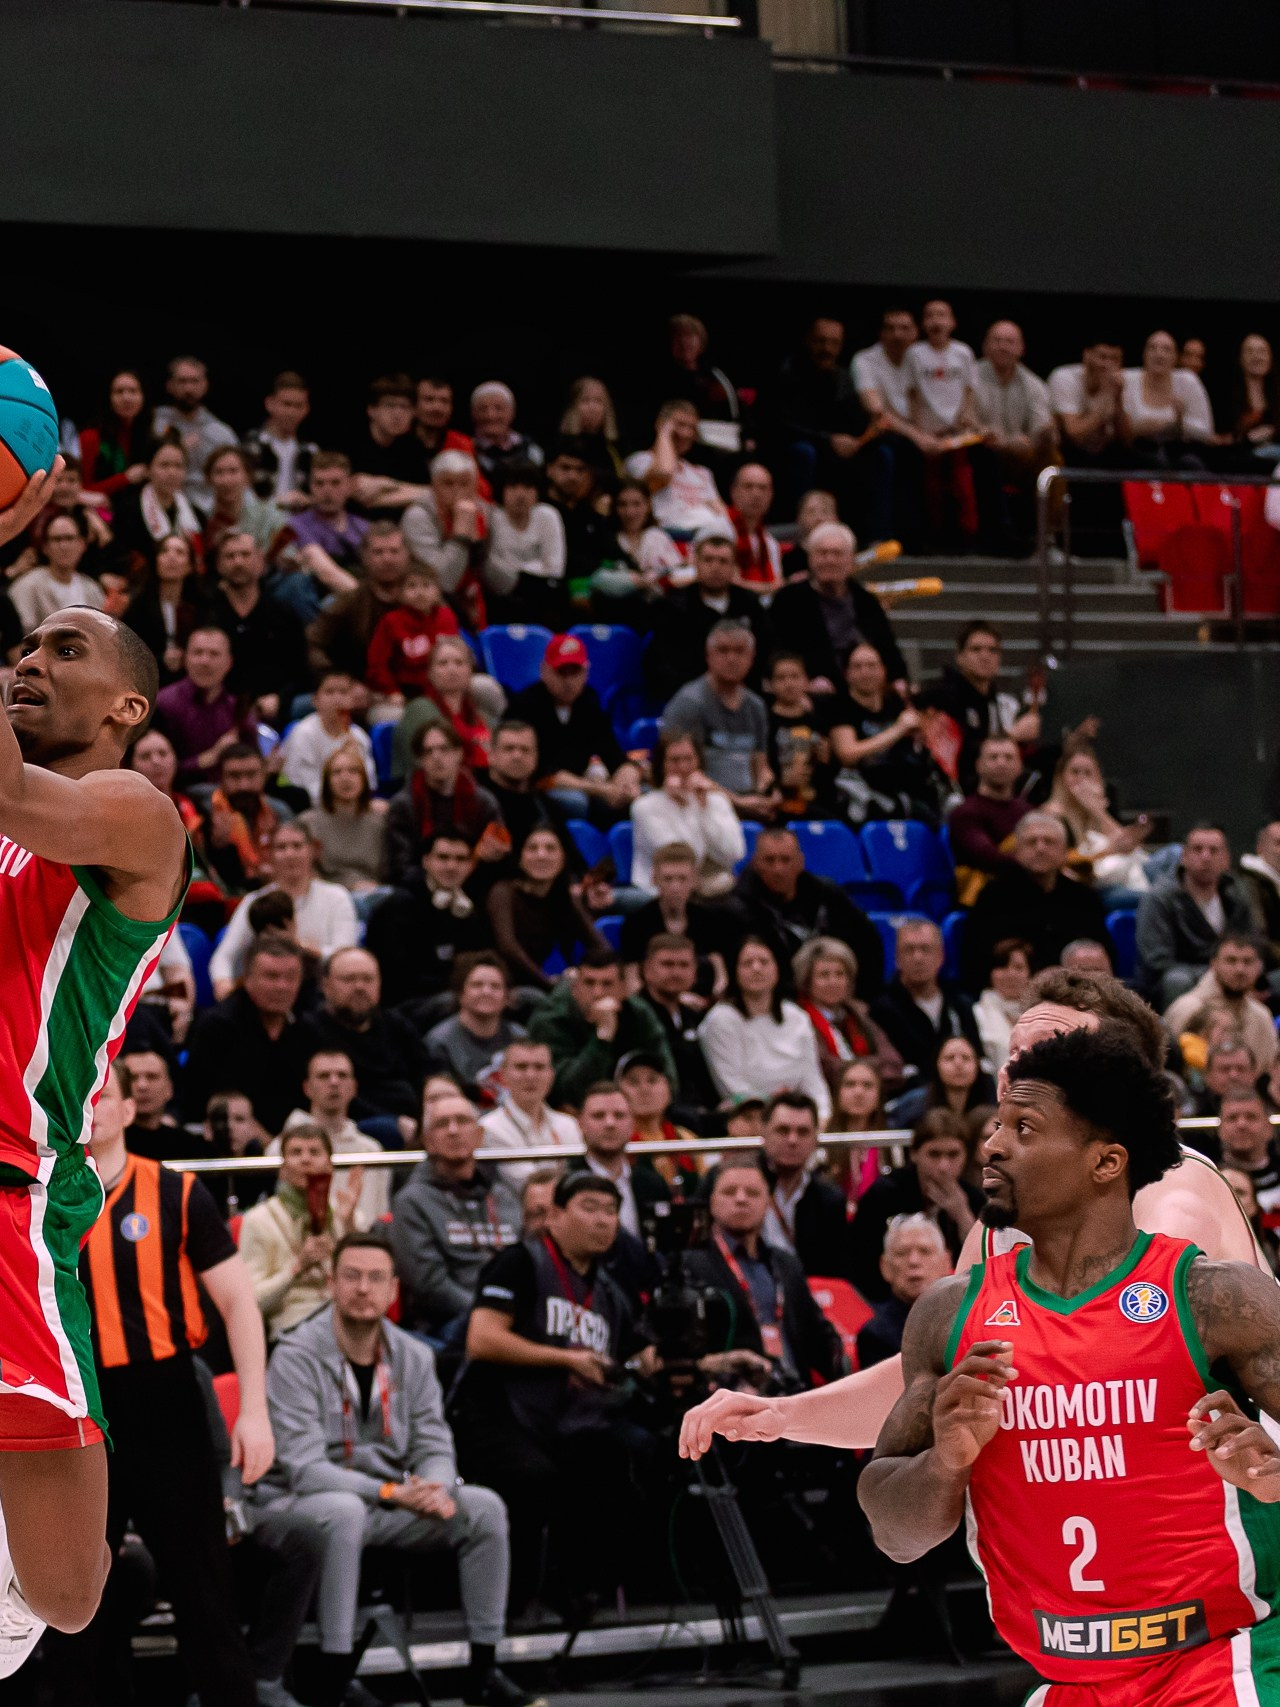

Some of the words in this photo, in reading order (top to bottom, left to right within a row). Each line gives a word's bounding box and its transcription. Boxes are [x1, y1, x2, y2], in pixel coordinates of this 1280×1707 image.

[1000, 1378, 1158, 1431] OKOMOTIV
[1019, 1434, 1127, 1483] KUBAN
[1061, 1515, 1106, 1592] 2
[1041, 1606, 1197, 1654] МЕЛБЕТ
